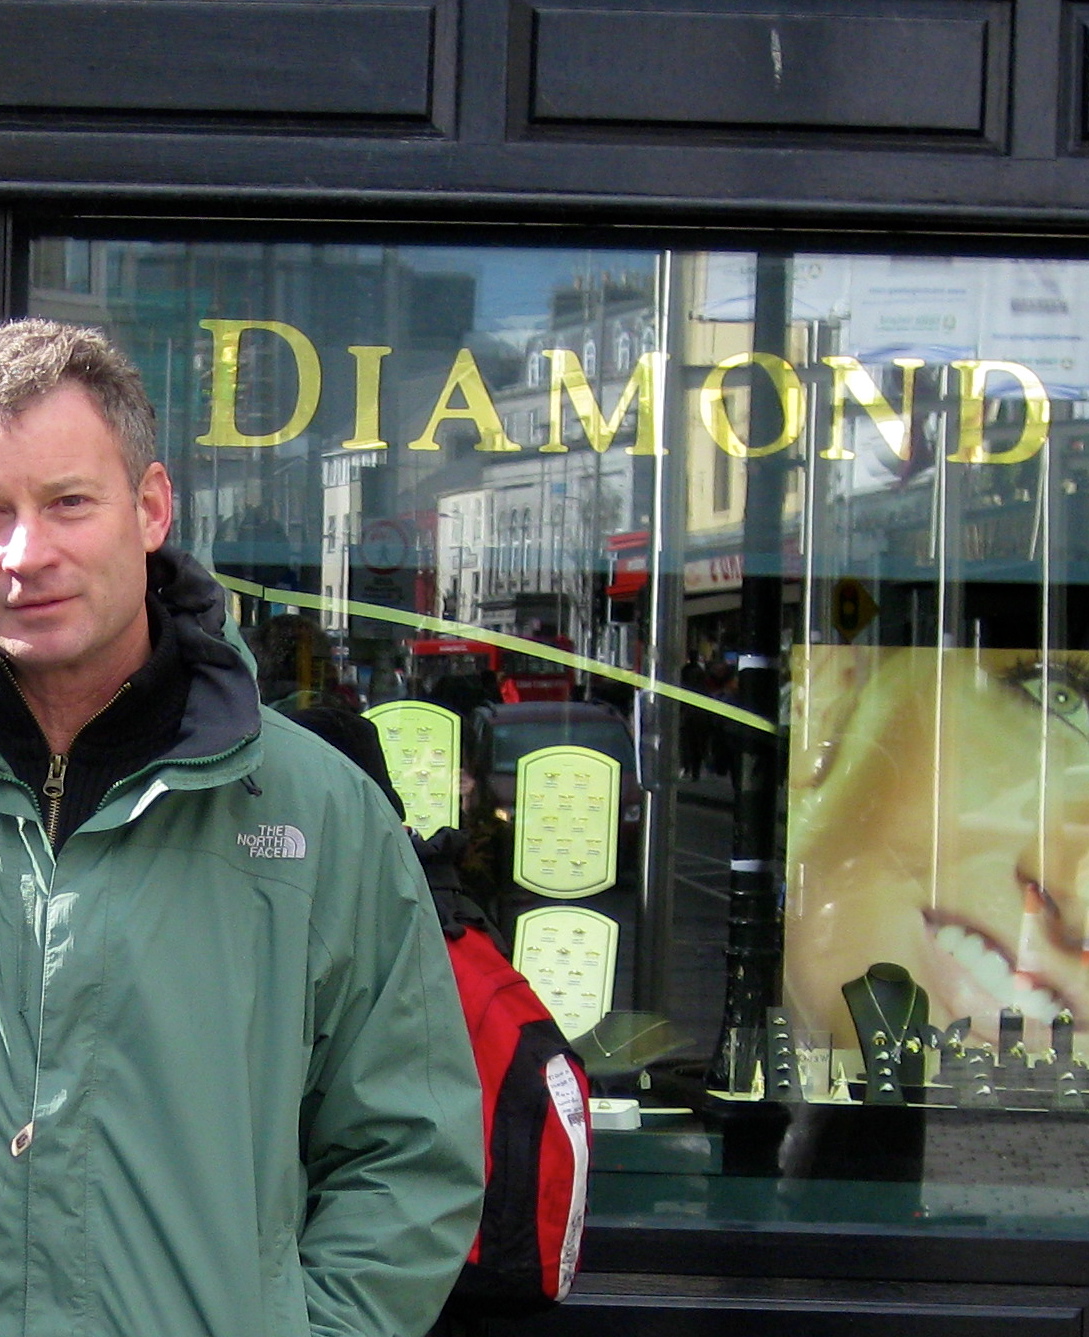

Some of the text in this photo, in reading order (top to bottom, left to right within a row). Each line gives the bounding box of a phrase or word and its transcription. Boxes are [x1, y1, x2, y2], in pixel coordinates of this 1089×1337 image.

[196, 318, 1051, 465] DIAMOND
[258, 824, 284, 837] THE
[236, 833, 283, 847] NORTH
[249, 847, 281, 859] FACE
